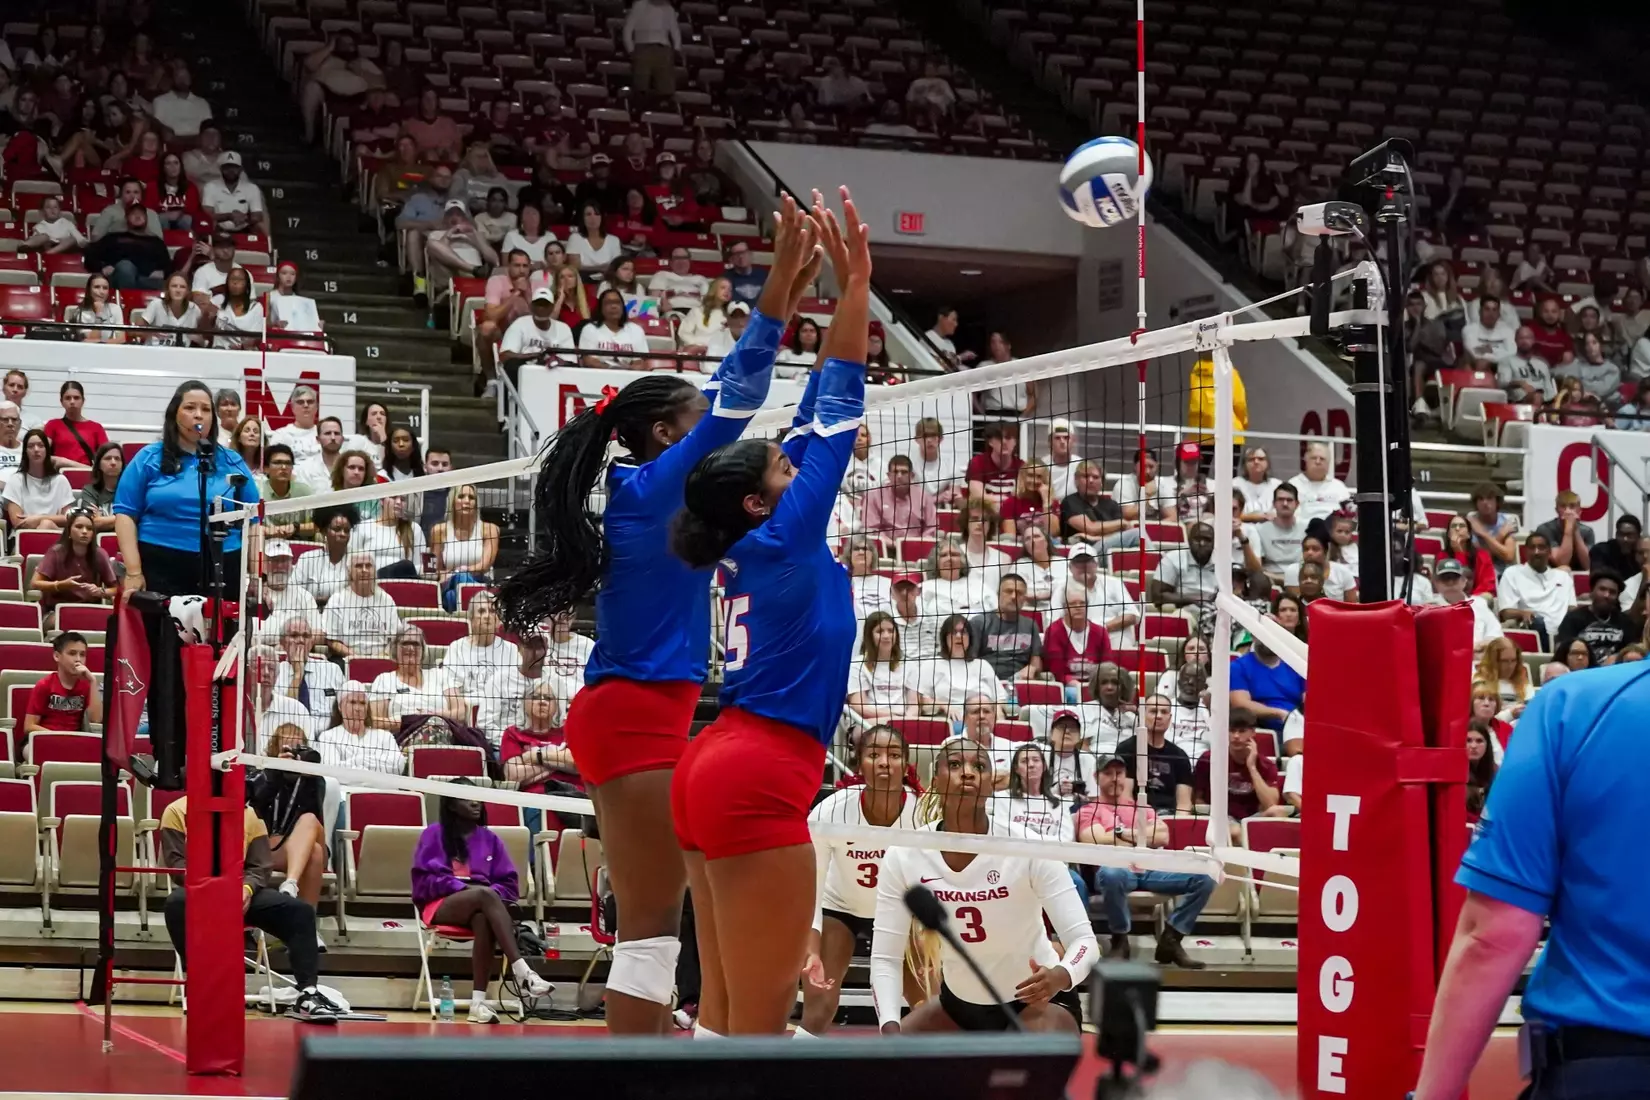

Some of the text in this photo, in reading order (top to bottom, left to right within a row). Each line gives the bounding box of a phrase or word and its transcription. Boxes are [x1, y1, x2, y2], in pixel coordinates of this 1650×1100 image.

[226, 153, 233, 161] A
[258, 161, 270, 171] 19
[272, 188, 284, 198] 18
[287, 217, 300, 228] 17
[305, 250, 318, 260] 16
[324, 281, 337, 292] 15
[343, 312, 357, 324] 14
[366, 346, 379, 358] 13
[244, 368, 319, 430] M
[408, 415, 420, 428] 11
[1420, 470, 1430, 482] 11
[1557, 442, 1609, 522] O
[856, 863, 879, 888] 3
[933, 886, 1009, 902] RKANSAS
[955, 906, 987, 943] 3
